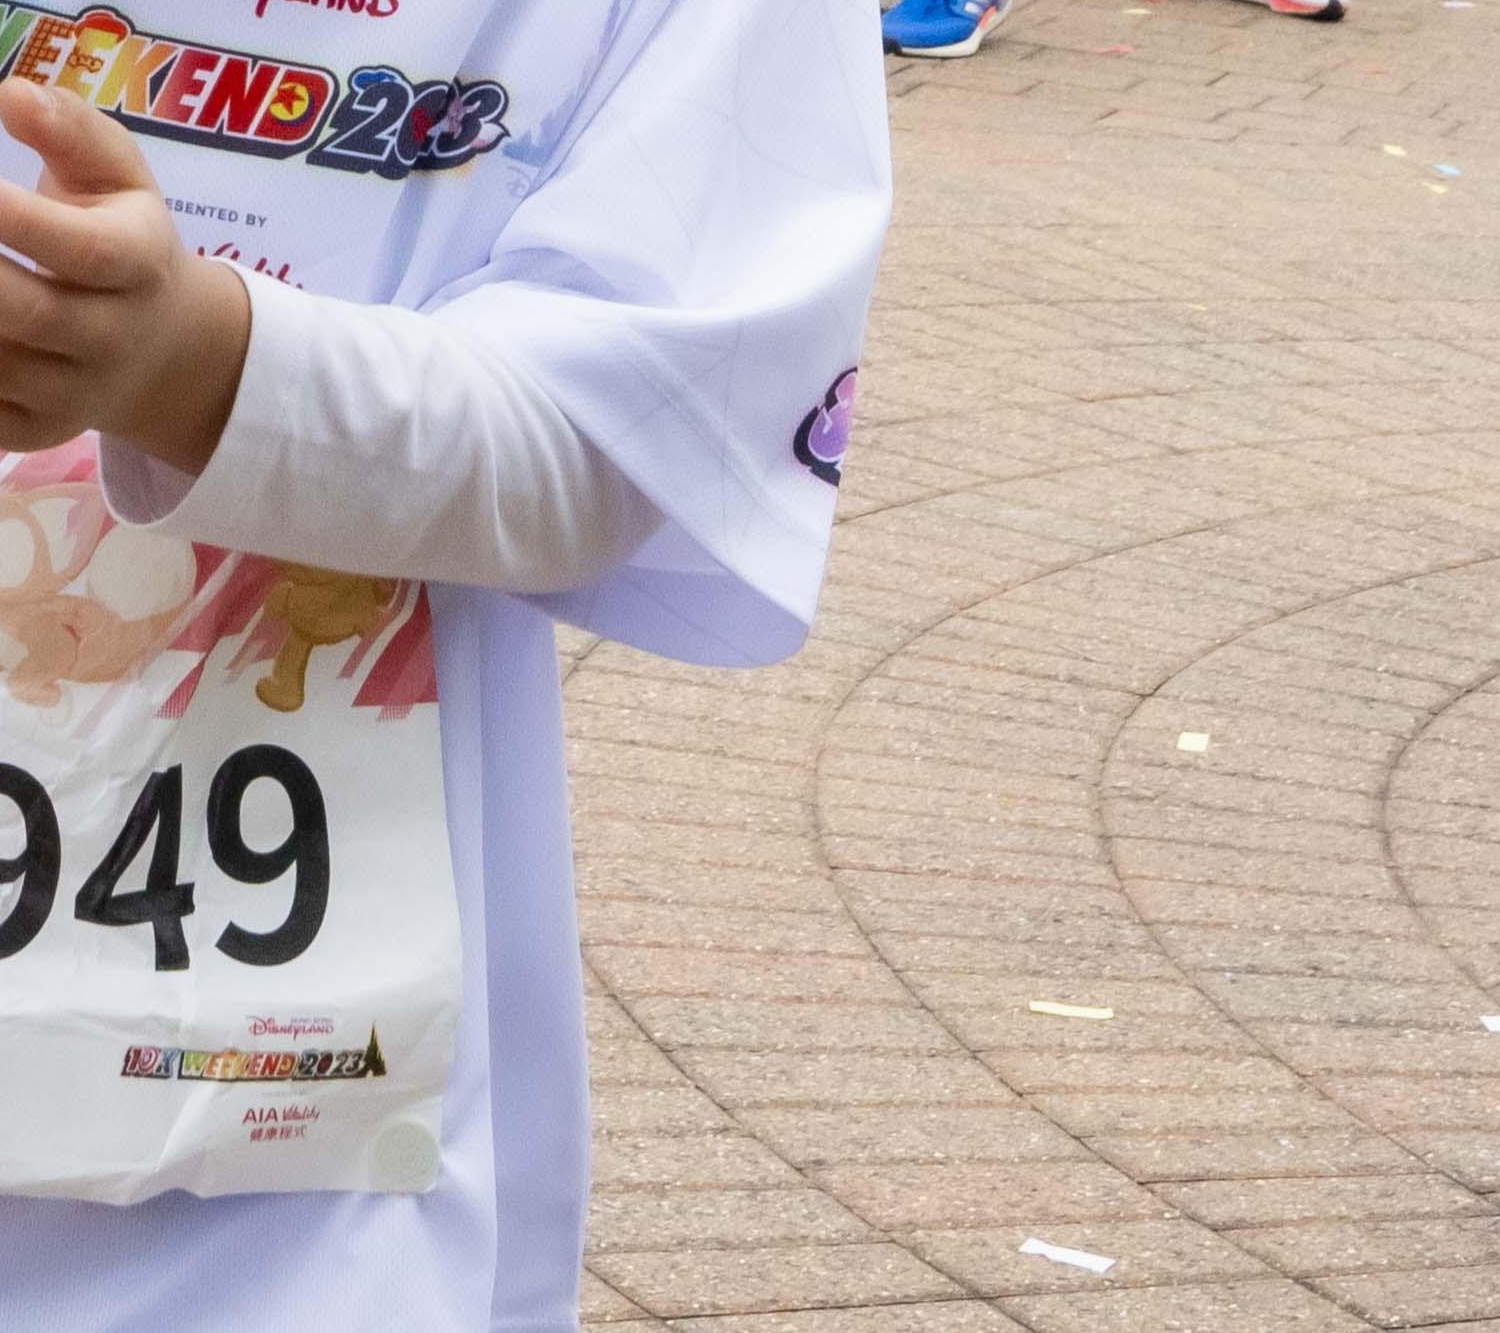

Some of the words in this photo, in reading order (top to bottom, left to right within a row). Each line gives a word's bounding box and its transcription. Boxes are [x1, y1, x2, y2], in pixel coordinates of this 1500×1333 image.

[165, 196, 239, 224] ESENTED
[245, 212, 268, 230] BY
[178, 1047, 298, 1081] WEEKEND
[293, 1048, 365, 1081] 2023
[242, 1107, 278, 1125] AIA
